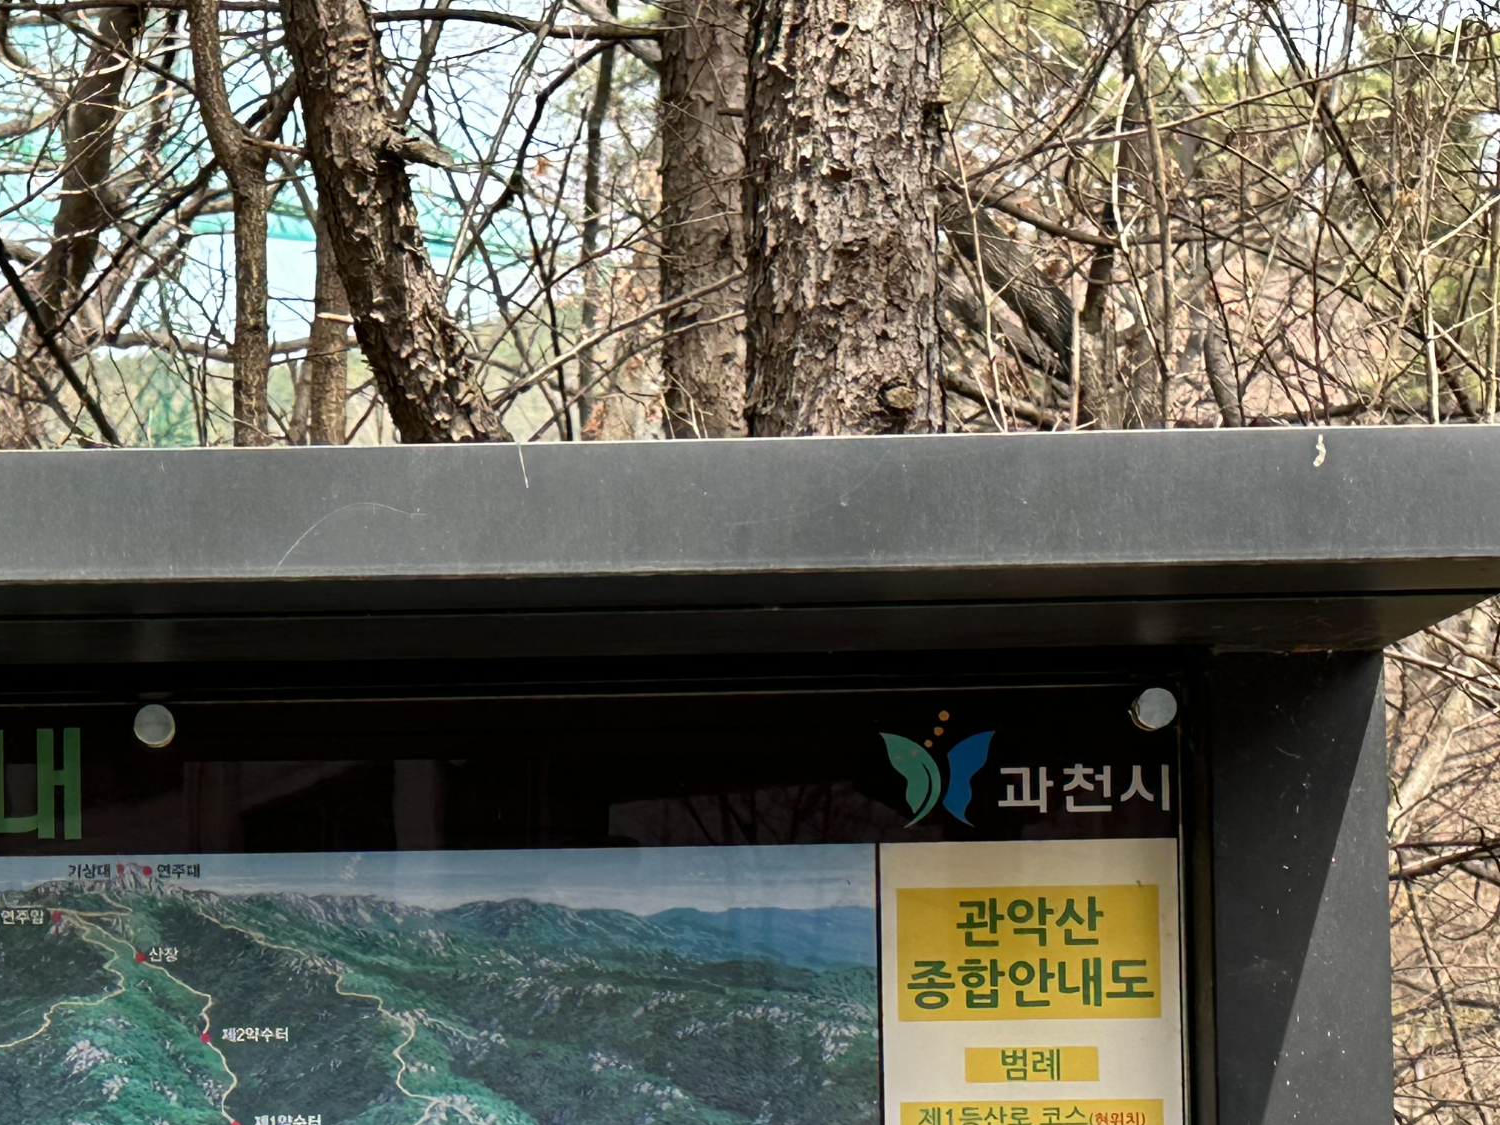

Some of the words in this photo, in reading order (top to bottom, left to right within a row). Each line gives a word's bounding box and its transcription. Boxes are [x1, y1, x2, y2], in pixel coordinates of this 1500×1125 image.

[998, 764, 1170, 813] 과천시
[157, 863, 201, 879] 연주대
[956, 896, 1104, 947] 관악산
[149, 947, 179, 963] 산장
[907, 957, 1155, 1010] 종합안내도
[222, 1027, 289, 1042] 제2약수터
[1001, 1048, 1061, 1081] 범례
